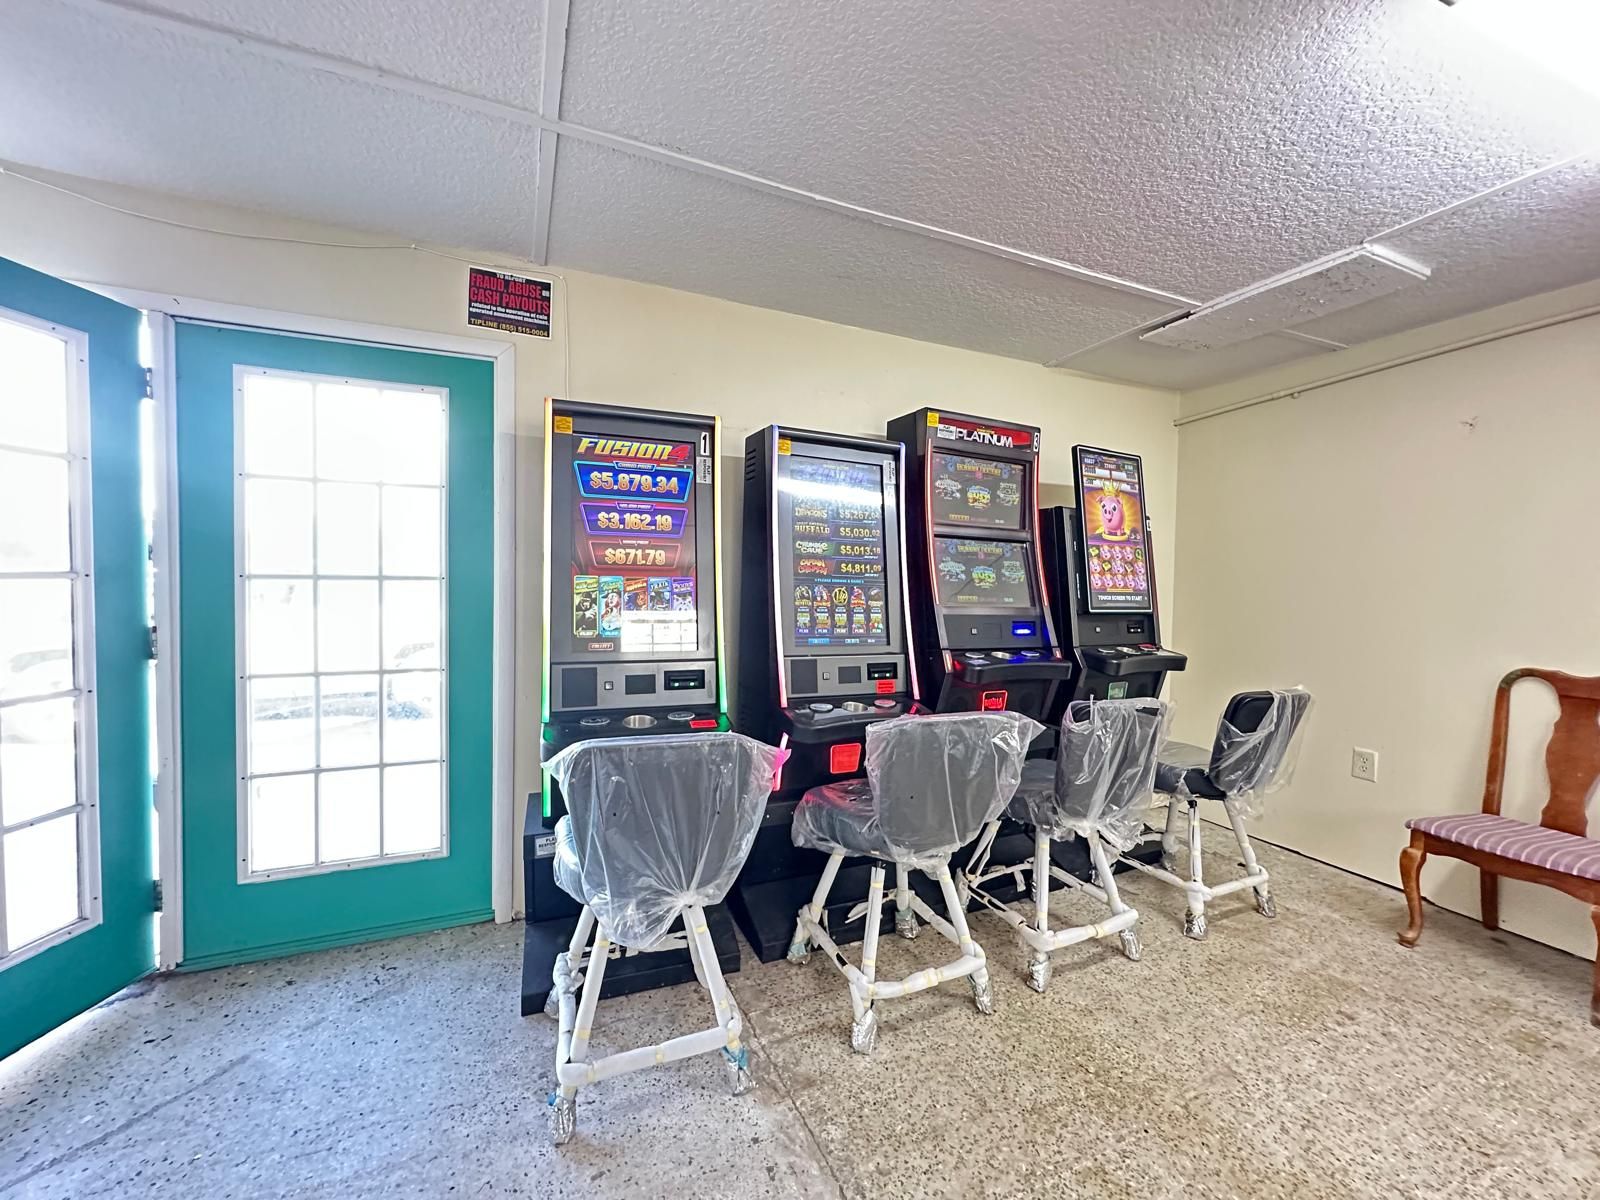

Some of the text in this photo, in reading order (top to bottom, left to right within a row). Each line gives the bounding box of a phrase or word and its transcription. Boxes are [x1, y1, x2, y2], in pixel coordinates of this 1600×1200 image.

[509, 281, 542, 299] ABUSE
[470, 288, 549, 314] CASH PAYOUTS
[471, 319, 498, 328] TIPLINE
[500, 323, 516, 332] (855)
[518, 327, 548, 337] 515-0004
[956, 428, 1014, 448] PLATINUM
